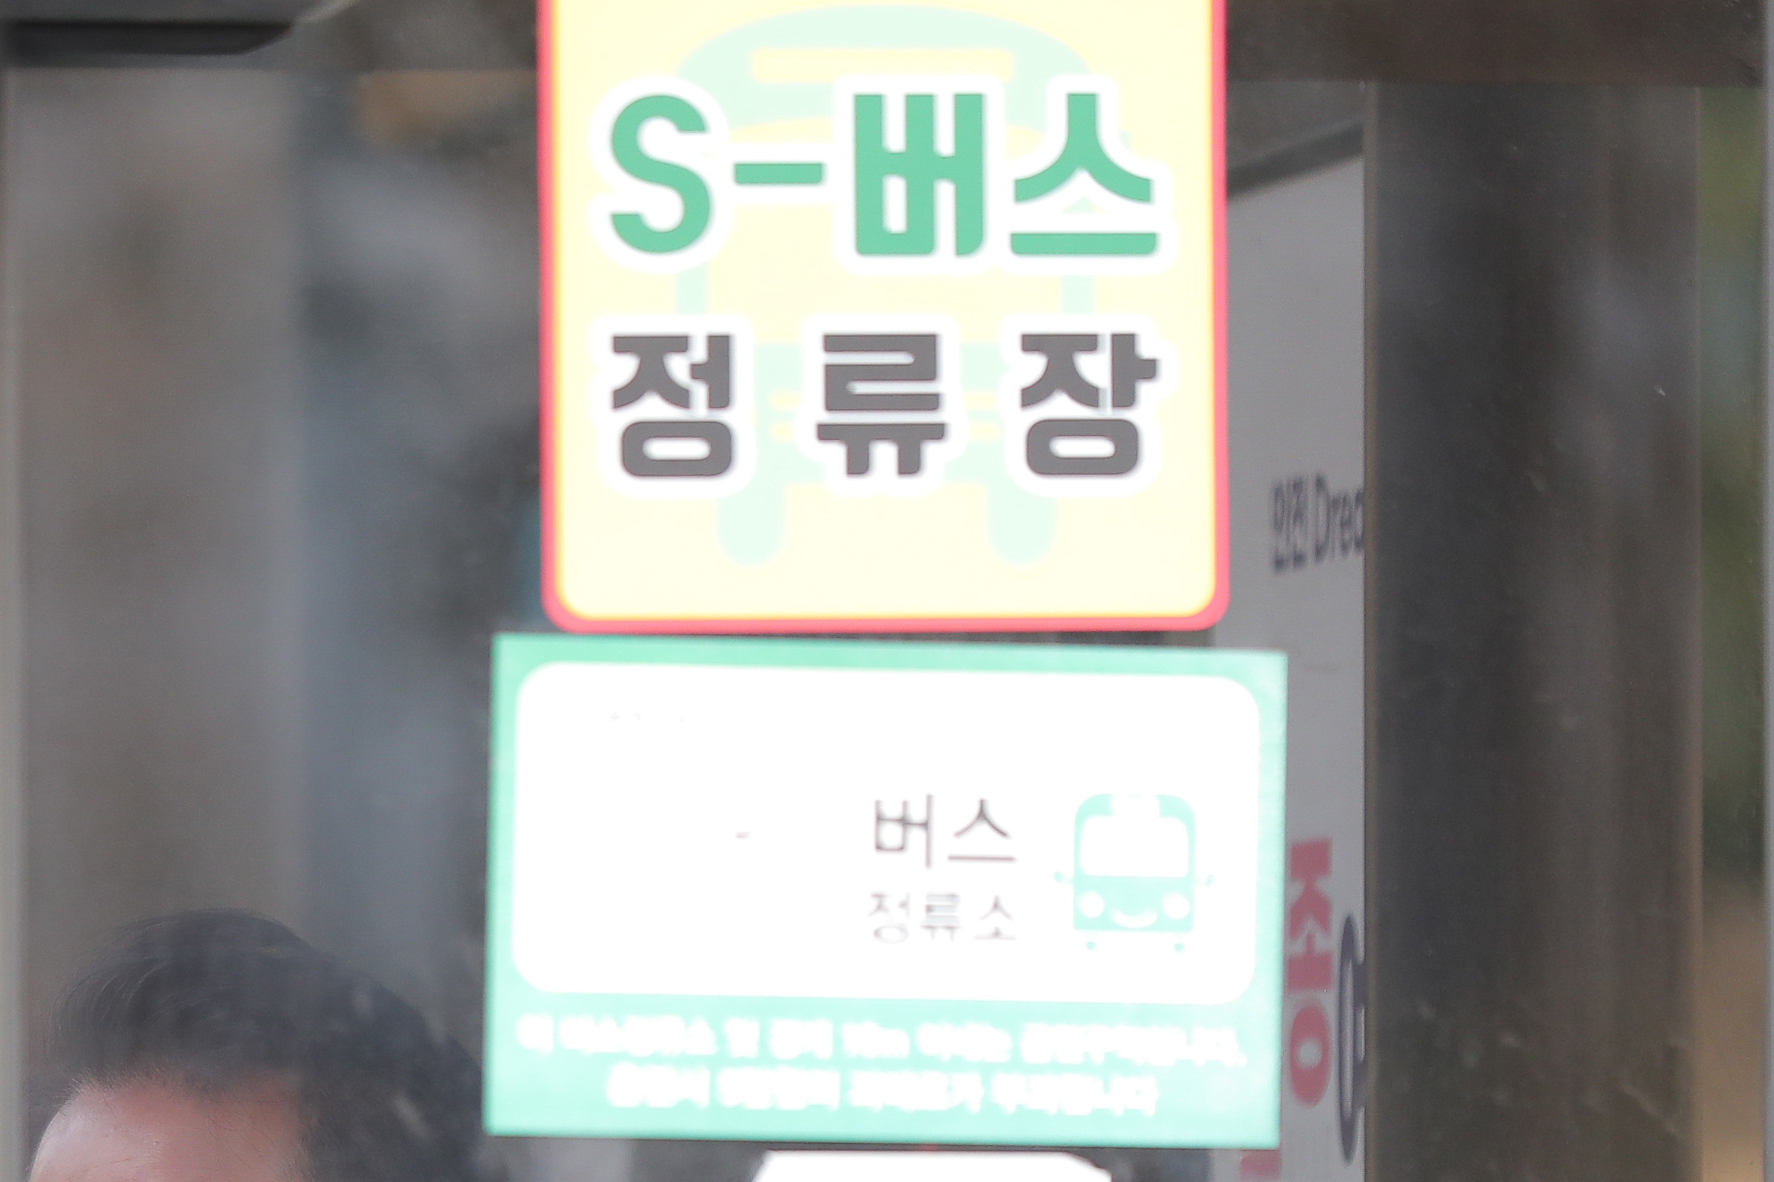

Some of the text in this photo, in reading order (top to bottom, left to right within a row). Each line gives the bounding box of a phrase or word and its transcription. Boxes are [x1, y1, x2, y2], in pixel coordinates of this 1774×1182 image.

[610, 91, 1160, 258] S-버스
[872, 792, 1019, 871] 버스
[866, 889, 1019, 945] 정류소
